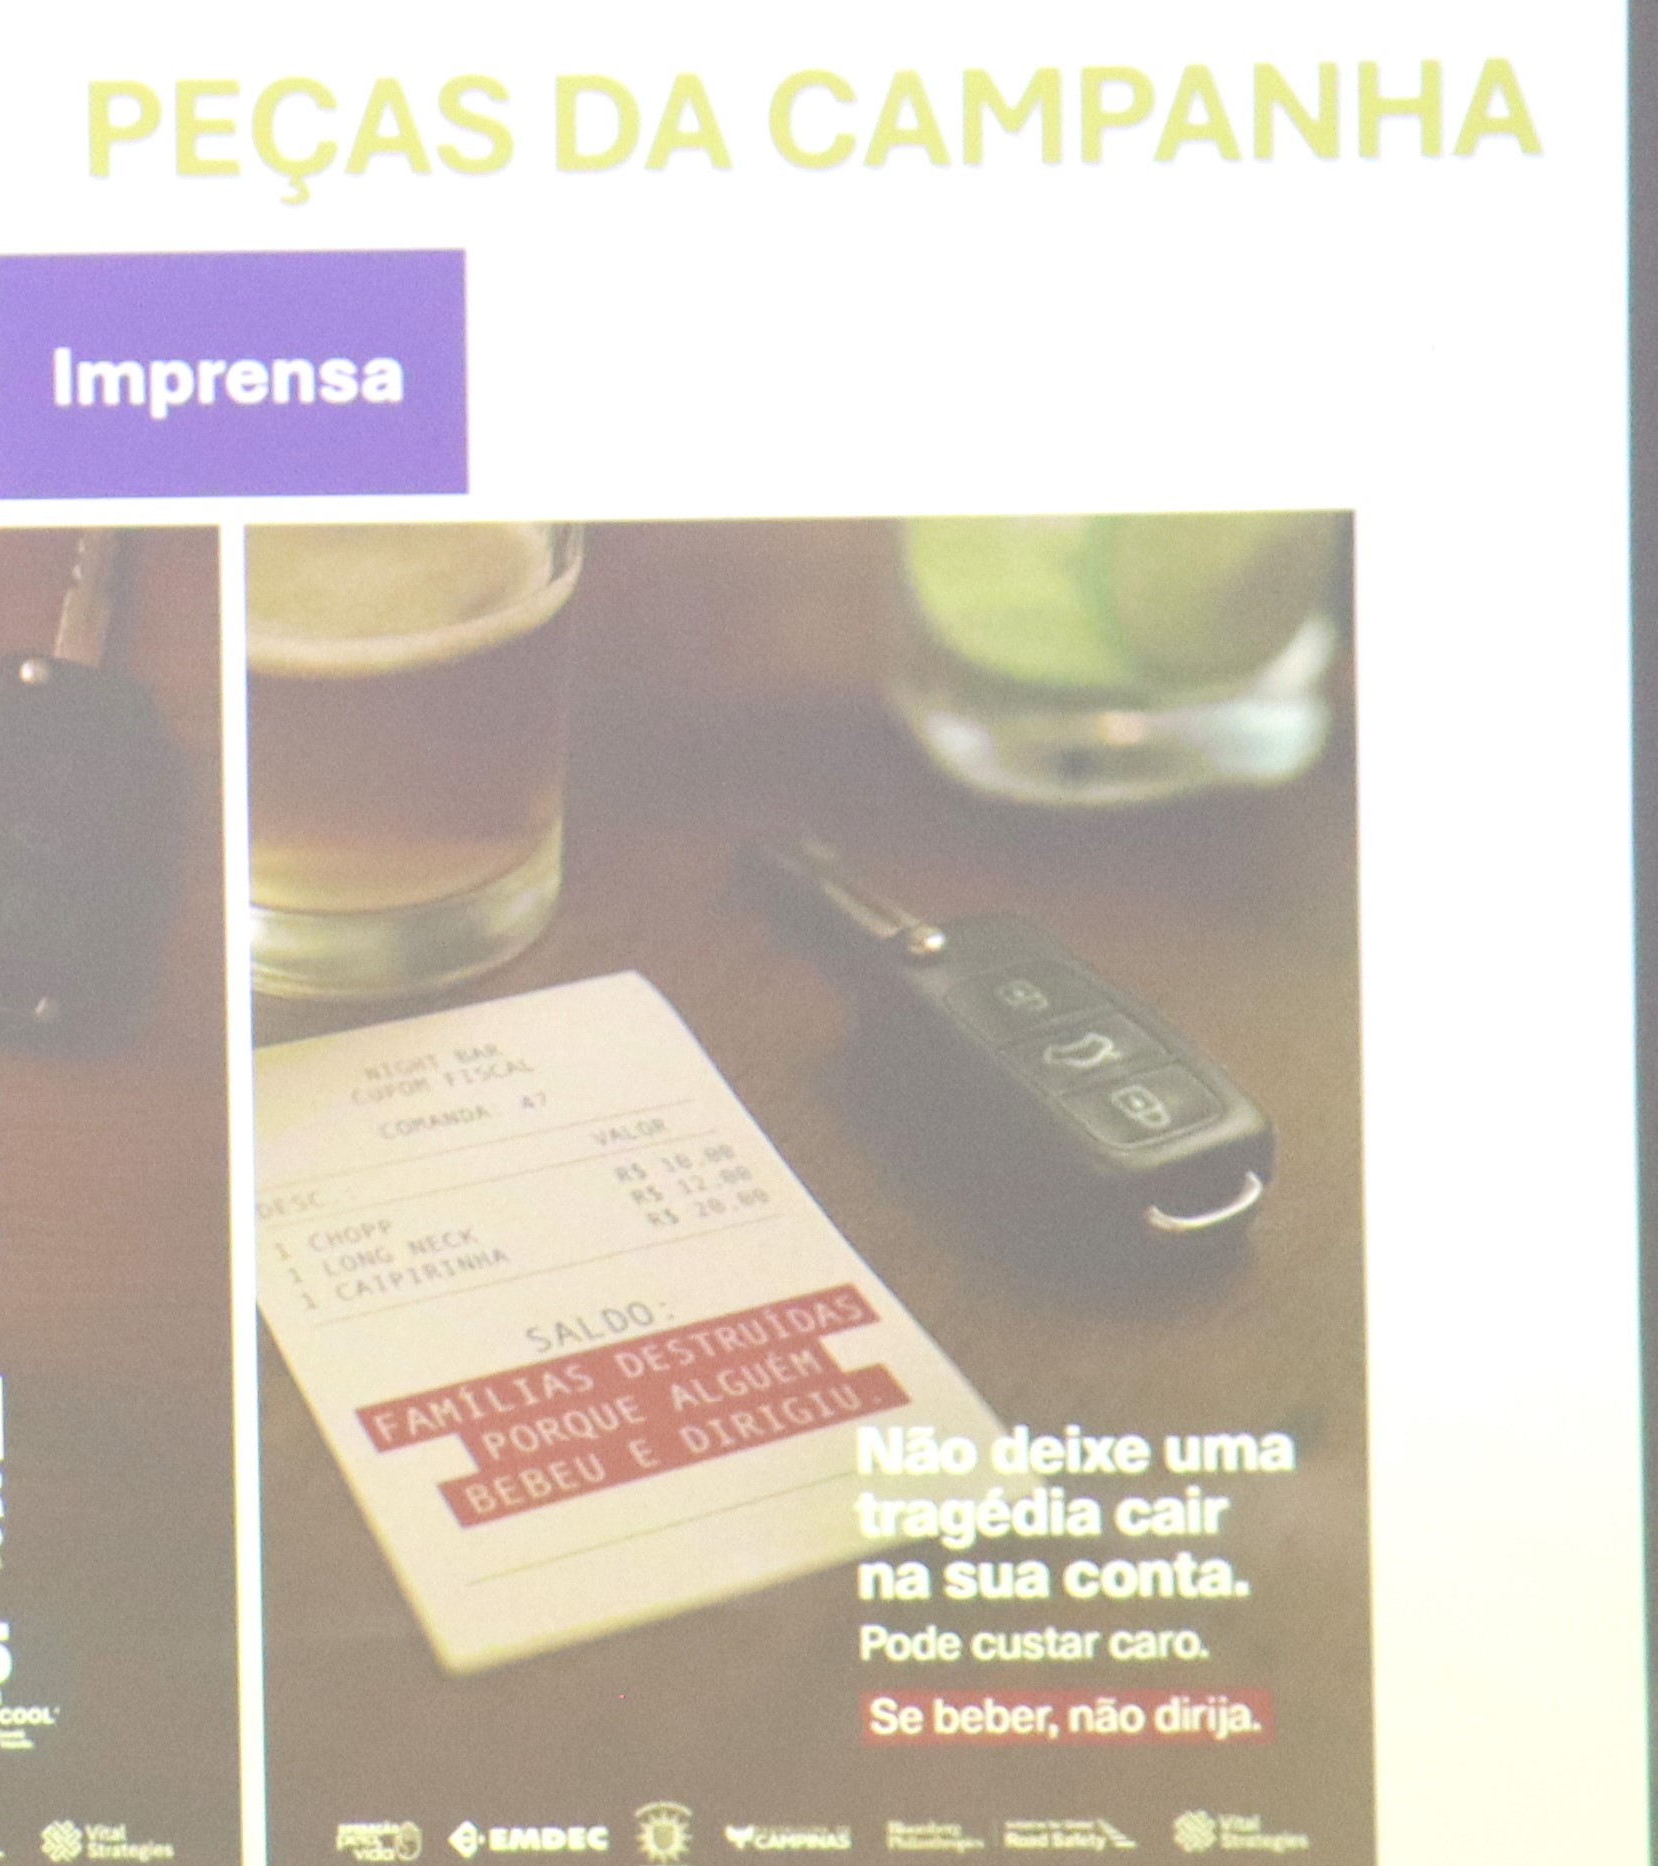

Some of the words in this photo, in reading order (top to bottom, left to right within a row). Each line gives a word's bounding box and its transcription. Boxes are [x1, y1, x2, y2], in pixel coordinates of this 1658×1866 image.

[87, 74, 515, 206] PEÇAS
[554, 72, 734, 174] DA
[766, 54, 1545, 170] CAMPANHA
[54, 346, 406, 420] Imprensa
[453, 1042, 502, 1066] BAR
[349, 1076, 432, 1107] CUPOM
[444, 1056, 536, 1090] FISCAL
[593, 1117, 669, 1148] VALOR
[307, 1217, 393, 1253] CHOPP
[322, 1246, 395, 1279] LONG
[408, 1226, 480, 1256] NECK
[334, 1246, 511, 1303] CAIPIRINHA
[525, 1299, 675, 1355] SALDO:
[372, 1363, 595, 1445] FAMÍLIAS
[614, 1293, 865, 1379] DESTRUÍDAS
[482, 1395, 647, 1462] PORQUE
[670, 1345, 823, 1413] ALGUÉM
[855, 1426, 978, 1475] Não
[991, 1425, 1151, 1474] deixe
[1164, 1432, 1296, 1472] uma
[464, 1452, 607, 1516] BEBEU
[627, 1439, 661, 1470] E
[855, 1487, 1103, 1550] tragédia
[1114, 1486, 1231, 1537] cair
[857, 1559, 932, 1601] na
[944, 1558, 1051, 1600] sua
[1062, 1551, 1251, 1599] conta.
[859, 1624, 963, 1662] Pode
[970, 1626, 1101, 1661] custar
[1108, 1631, 1210, 1661] caro.
[869, 1697, 924, 1737] Se
[933, 1697, 1059, 1740] beber,
[1068, 1697, 1146, 1734] não
[1154, 1696, 1263, 1740] dirija.
[85, 1823, 127, 1843] Vital
[489, 1825, 609, 1852] EMDEC
[753, 1832, 852, 1851] CAMPINAS
